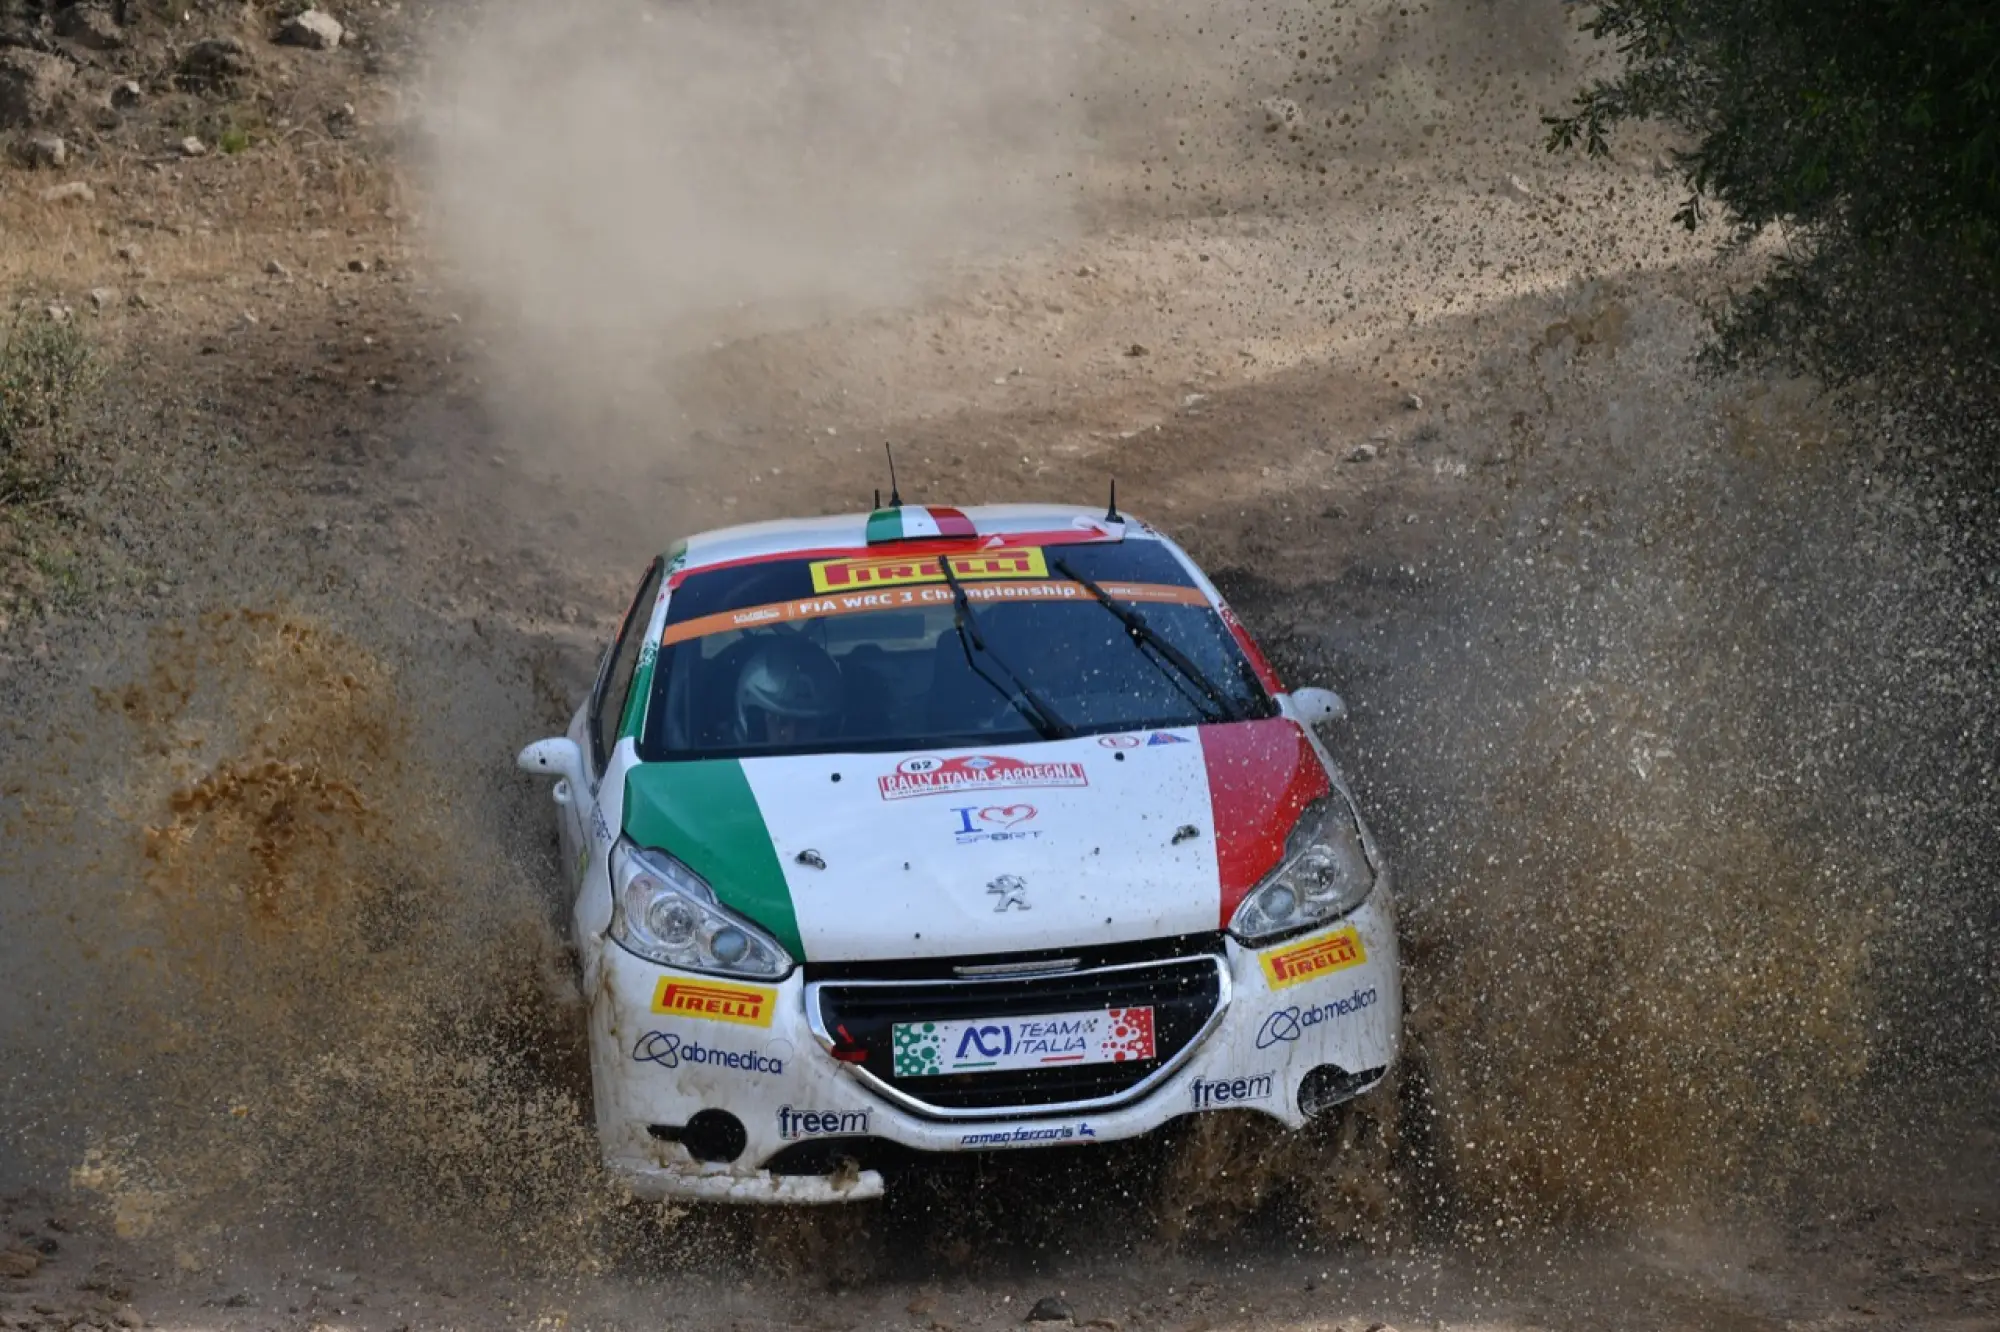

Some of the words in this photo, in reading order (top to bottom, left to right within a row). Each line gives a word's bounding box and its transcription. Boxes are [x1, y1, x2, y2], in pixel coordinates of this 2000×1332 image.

[824, 551, 1030, 586] PIRELLI
[800, 599, 836, 614] FIA
[843, 592, 893, 609] WRC
[900, 591, 913, 603] 3
[887, 773, 933, 792] RALLY
[938, 769, 990, 786] ITALIA
[992, 763, 1077, 781] SARDEGNA
[910, 760, 933, 771] 62
[950, 806, 983, 835] I
[955, 830, 1044, 845] SPORT
[1271, 936, 1357, 982] PIRELLI
[662, 983, 764, 1019] PIRELLI
[955, 1025, 1013, 1059] ACI
[1019, 1020, 1082, 1038] TEAM
[1014, 1036, 1087, 1055] ITALIA
[1192, 1075, 1272, 1108] freem
[779, 1105, 869, 1138] freem
[960, 1131, 1011, 1145] romeo
[1011, 1125, 1074, 1141] ferraris
